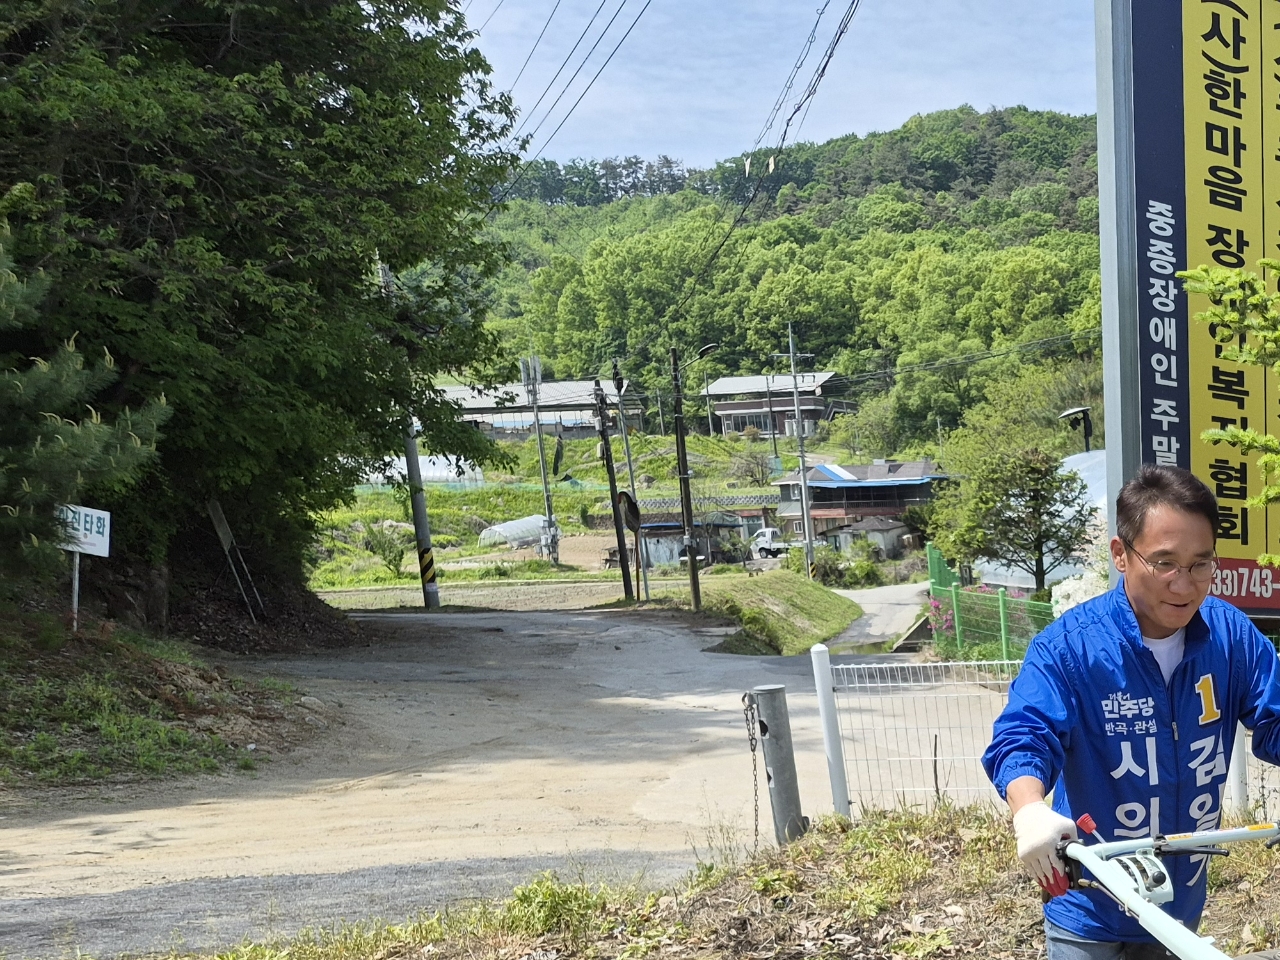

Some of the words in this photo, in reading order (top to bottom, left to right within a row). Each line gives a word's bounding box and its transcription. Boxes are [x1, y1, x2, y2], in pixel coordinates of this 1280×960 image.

[1146, 199, 1178, 388] 중증장애인
[1101, 697, 1155, 718] 민주당
[1195, 673, 1221, 726] 1
